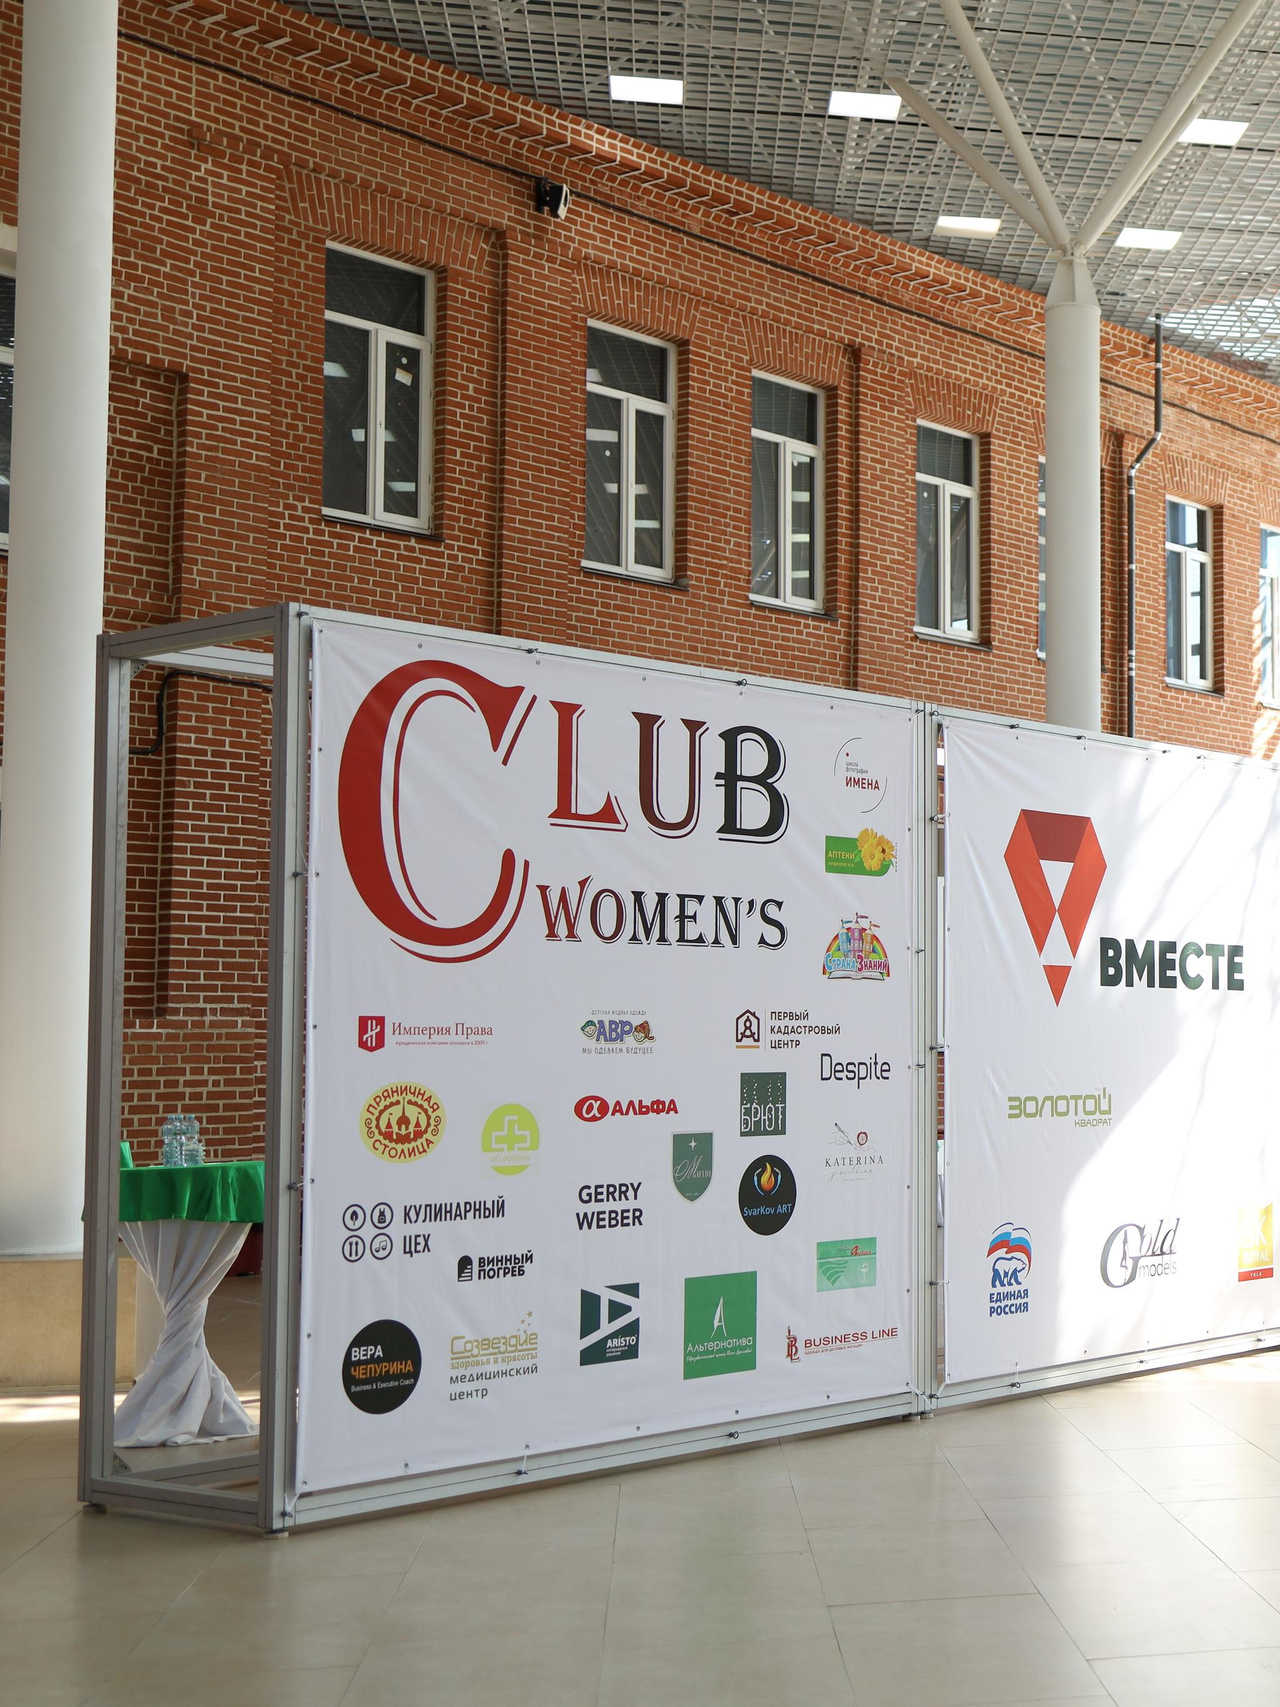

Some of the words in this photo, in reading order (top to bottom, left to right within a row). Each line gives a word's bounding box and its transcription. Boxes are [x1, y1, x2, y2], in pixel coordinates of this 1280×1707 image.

[846, 776, 880, 791] ИМЕНА
[338, 660, 790, 963] CLUB
[828, 850, 855, 860] АПТЕКИ
[535, 875, 788, 950] WOMEN'S
[1099, 936, 1245, 992] ВМЕСТЕ
[770, 1010, 810, 1021] ПЕРВЫЙ
[392, 1022, 451, 1040] Империя
[455, 1022, 494, 1040] Права
[770, 1024, 841, 1036] КАДАСТРОВЫЙ
[770, 1040, 800, 1050] ЦЕНТР
[820, 1053, 891, 1090] Despite
[366, 1085, 440, 1116] ПРЯНИЧНАЯ
[610, 1098, 679, 1116] АЛЬФА
[1008, 1087, 1112, 1118] ЗОЛОТОЙ
[740, 1103, 786, 1132] БРЮТ
[1074, 1118, 1112, 1128] КВАДРАТ
[372, 1138, 434, 1160] СТОЛИЦА
[502, 1154, 530, 1162] ФОКИНА
[824, 1155, 884, 1168] KATERINA
[578, 1182, 642, 1205] GERRY
[403, 1195, 506, 1225] КУЛИНАРНЫЙ
[744, 1204, 775, 1217] SvarKov
[776, 1204, 792, 1214] ART
[576, 1208, 644, 1231] WEBER
[403, 1234, 431, 1258] ЦЕХ
[1100, 1218, 1180, 1288] Gold
[478, 1250, 534, 1268] ВИННЫЙ
[1138, 1257, 1178, 1278] models
[478, 1264, 526, 1280] ПОГРЕБ
[990, 1288, 1028, 1304] ЕДИНАЯ
[990, 1302, 1028, 1317] РОССИЯ
[687, 1336, 753, 1354] Альтернатива
[804, 1331, 868, 1348] BUSINESS
[871, 1327, 898, 1340] LINE
[351, 1345, 384, 1361] ВЕРА
[450, 1358, 490, 1370] здоровья
[501, 1352, 538, 1365] красоты
[351, 1359, 414, 1379] ЧЕПУРИНА
[450, 1364, 538, 1385] медицинский
[351, 1384, 372, 1392] Business
[378, 1380, 398, 1390] Executive
[400, 1378, 414, 1387] Coach
[450, 1387, 488, 1402] центр
